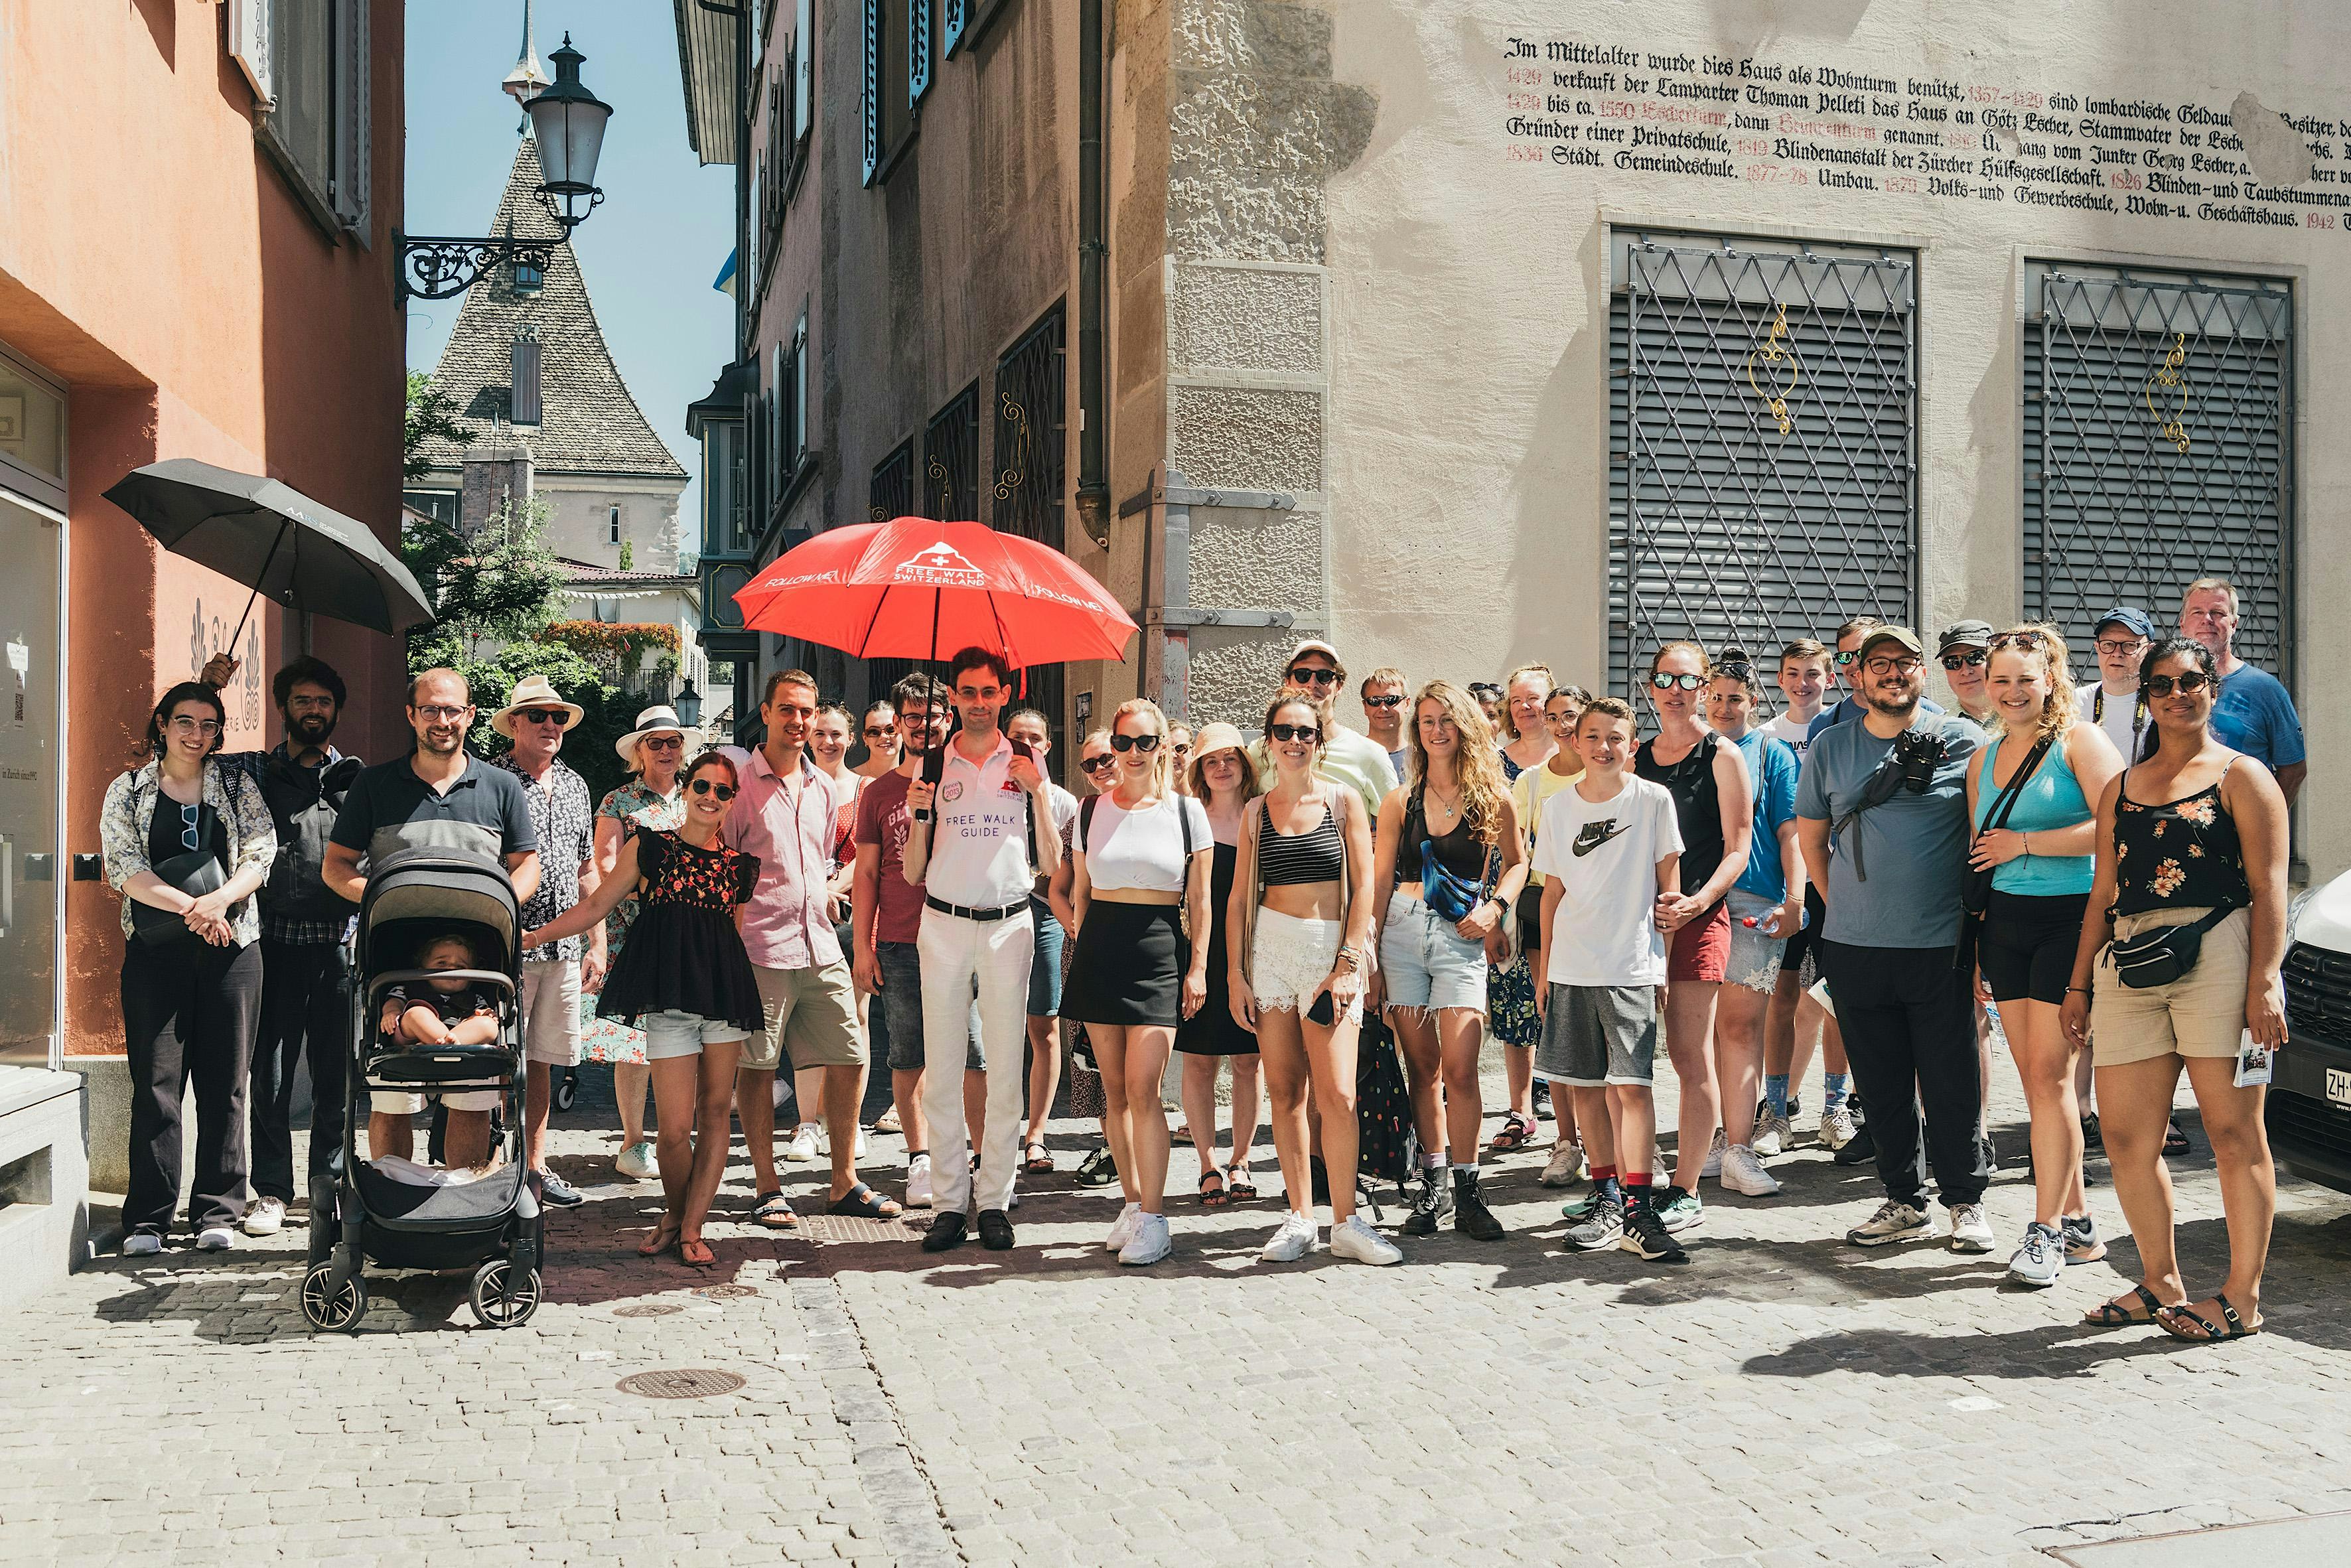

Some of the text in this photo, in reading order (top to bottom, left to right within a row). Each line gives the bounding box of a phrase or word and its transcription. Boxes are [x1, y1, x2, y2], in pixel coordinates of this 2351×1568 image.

[1504, 37, 1538, 58] Im
[1545, 42, 1639, 68] Mittelalter
[1648, 53, 1695, 74] wurde
[1703, 55, 1733, 76] dies
[1738, 58, 1782, 82] Haus
[1789, 66, 1812, 85] als
[1816, 67, 1897, 94] Wohnturm
[2049, 92, 2078, 111] sind
[2086, 96, 2171, 121] lombardische
[1553, 70, 1616, 94] verkauft
[1624, 74, 1649, 94] der
[1746, 85, 1810, 109] Thoman
[1873, 96, 1899, 118] das
[1906, 99, 1947, 122] Haus
[1956, 109, 1975, 125] an
[2080, 119, 2171, 144] Stammvater
[2180, 127, 2200, 147] der
[1547, 94, 1569, 113] bis
[1577, 101, 1595, 115] ca.
[1735, 111, 1770, 131] dann
[1884, 129, 1944, 147] genannt.
[2054, 144, 2082, 160] vom
[2090, 145, 2137, 165] Junker
[1506, 115, 1579, 140] Gründer
[1587, 121, 1624, 143] einer
[1772, 138, 1887, 167] Blindenanstalt
[1892, 150, 1914, 169] der
[2244, 181, 2351, 207] Taubstummena
[1614, 149, 1738, 178] Gemeindeschule.
[2198, 202, 2298, 226] Geschäftshaus.
[2306, 212, 2334, 230] 1942
[764, 574, 816, 588] FOLLOW
[894, 573, 985, 586] SWITZERLAND
[896, 566, 985, 579] FREE WALK
[946, 788, 960, 798] 2013
[946, 814, 1015, 826] FREE WALK
[961, 827, 999, 837] GUIDE
[1578, 818, 1617, 842] NIKE
